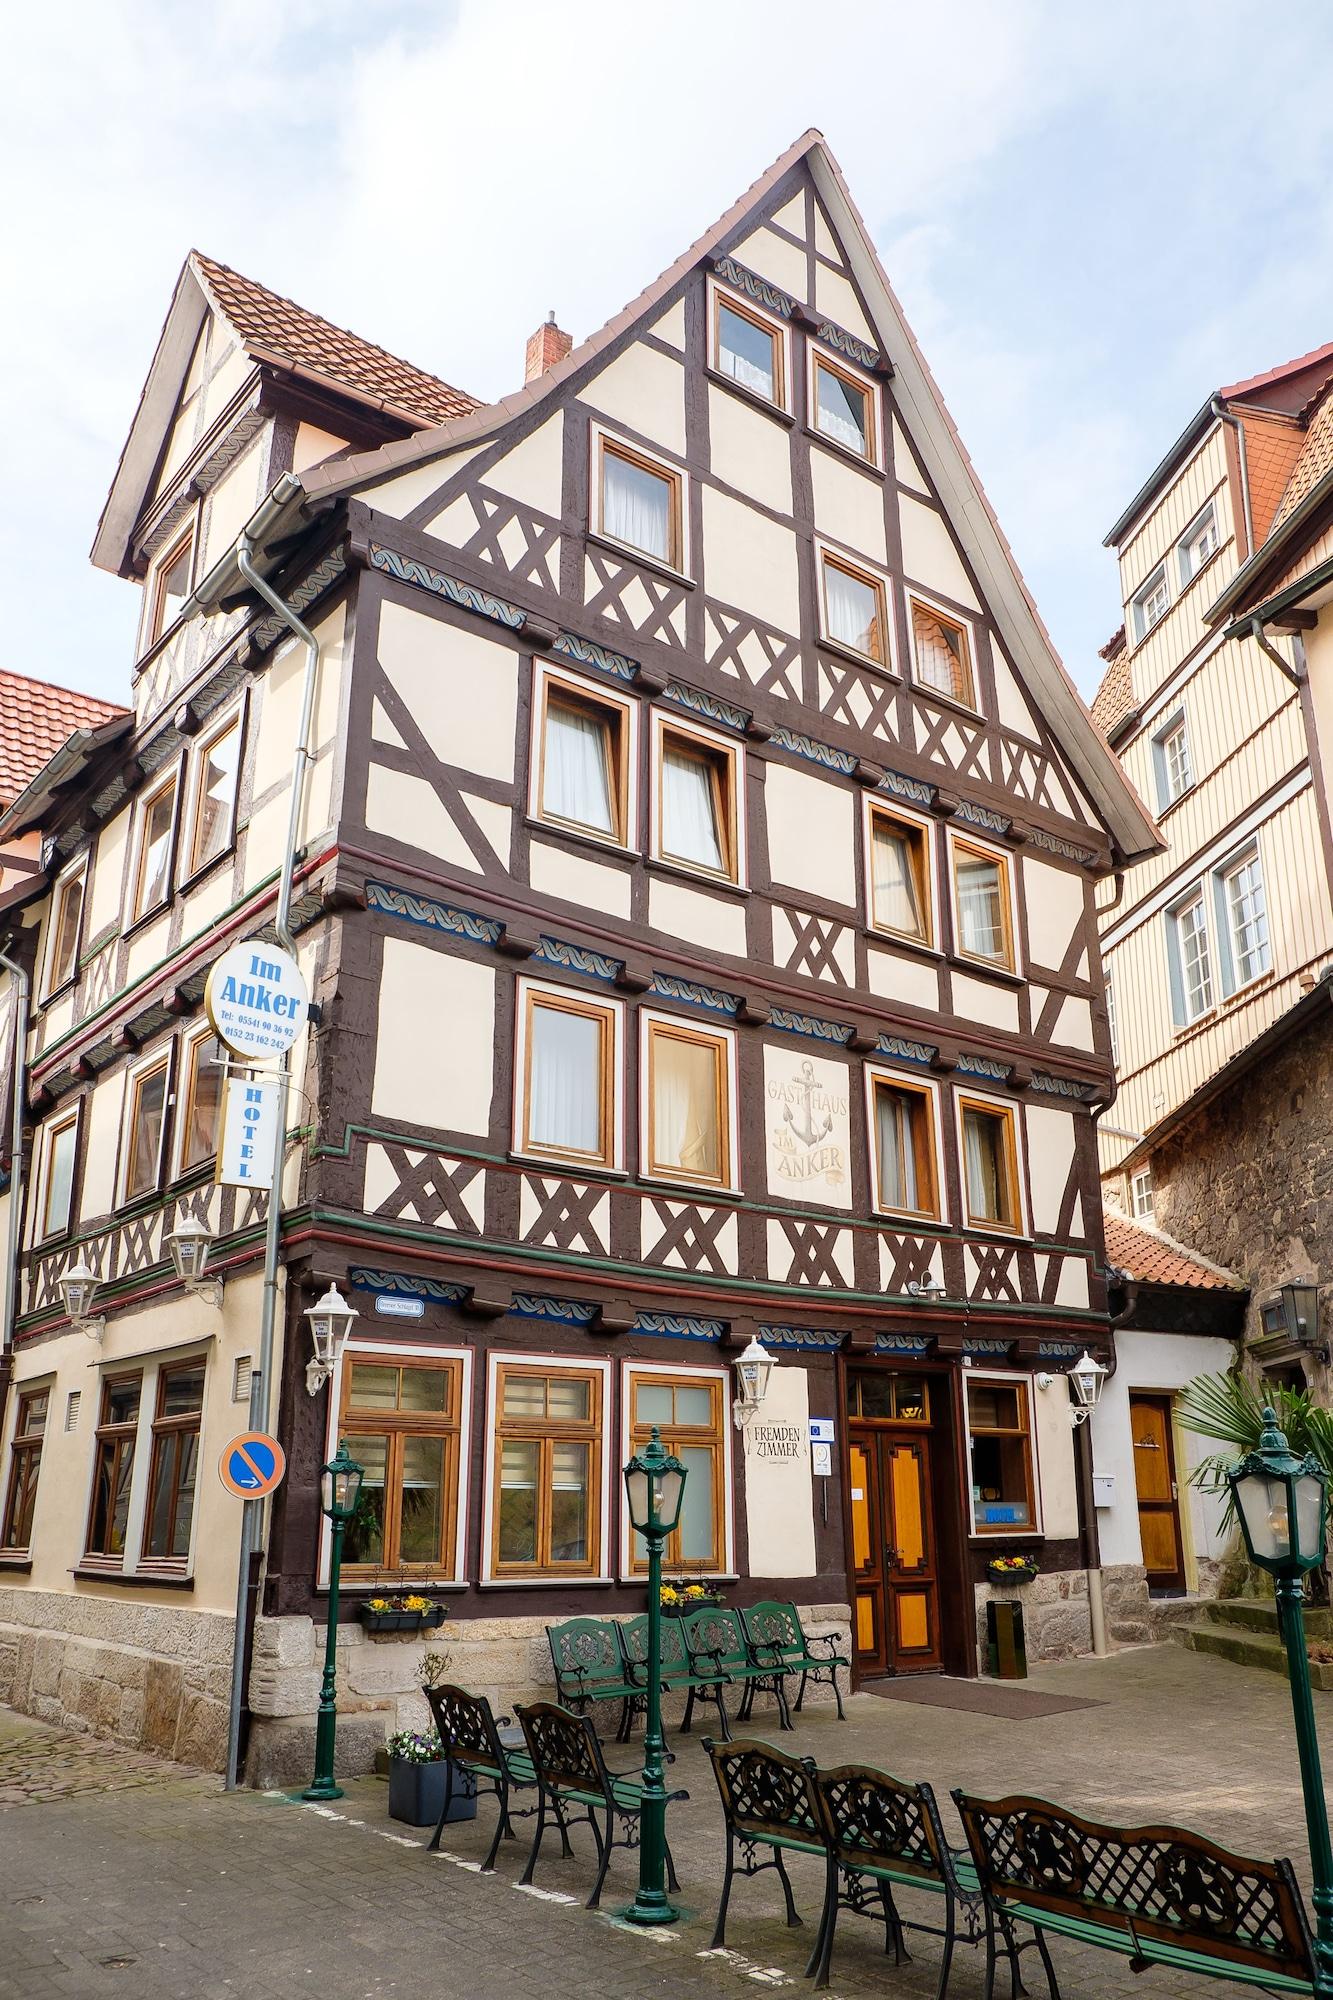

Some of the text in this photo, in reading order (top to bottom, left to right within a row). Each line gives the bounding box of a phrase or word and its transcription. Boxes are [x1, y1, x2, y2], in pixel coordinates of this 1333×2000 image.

[249, 955, 282, 983] Im
[220, 975, 301, 1020] Anker
[221, 1010, 294, 1037] Tel: 05541 90 36 92
[225, 1026, 285, 1050] 0152 23 162 242
[239, 1087, 264, 1179] HOTEL
[777, 1147, 843, 1178] ANKER
[755, 1427, 800, 1441] FREMDEN
[757, 1442, 800, 1458] ZIMMER
